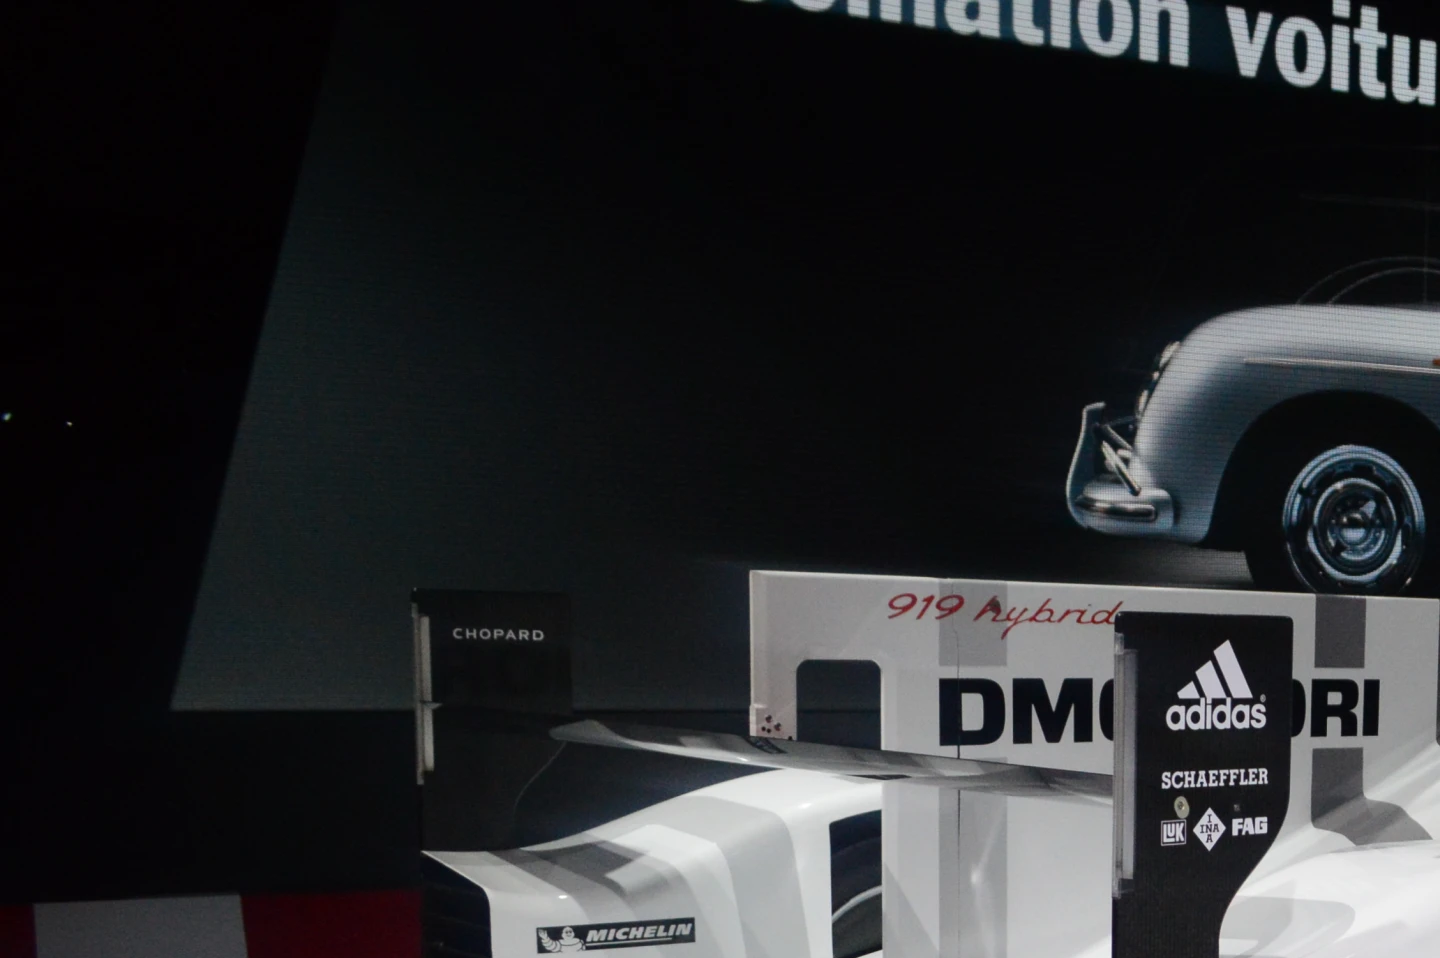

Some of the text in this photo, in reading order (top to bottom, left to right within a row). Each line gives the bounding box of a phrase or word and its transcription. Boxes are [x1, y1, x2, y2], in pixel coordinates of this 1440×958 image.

[888, 592, 1124, 641] 919 hybrid
[452, 626, 545, 642] CHOPARD
[938, 676, 1114, 747] DM
[1165, 696, 1267, 731] adidas
[1160, 767, 1269, 790] SCHAEFFLER
[1231, 816, 1269, 837] FAG
[585, 921, 693, 943] MICHELIN
